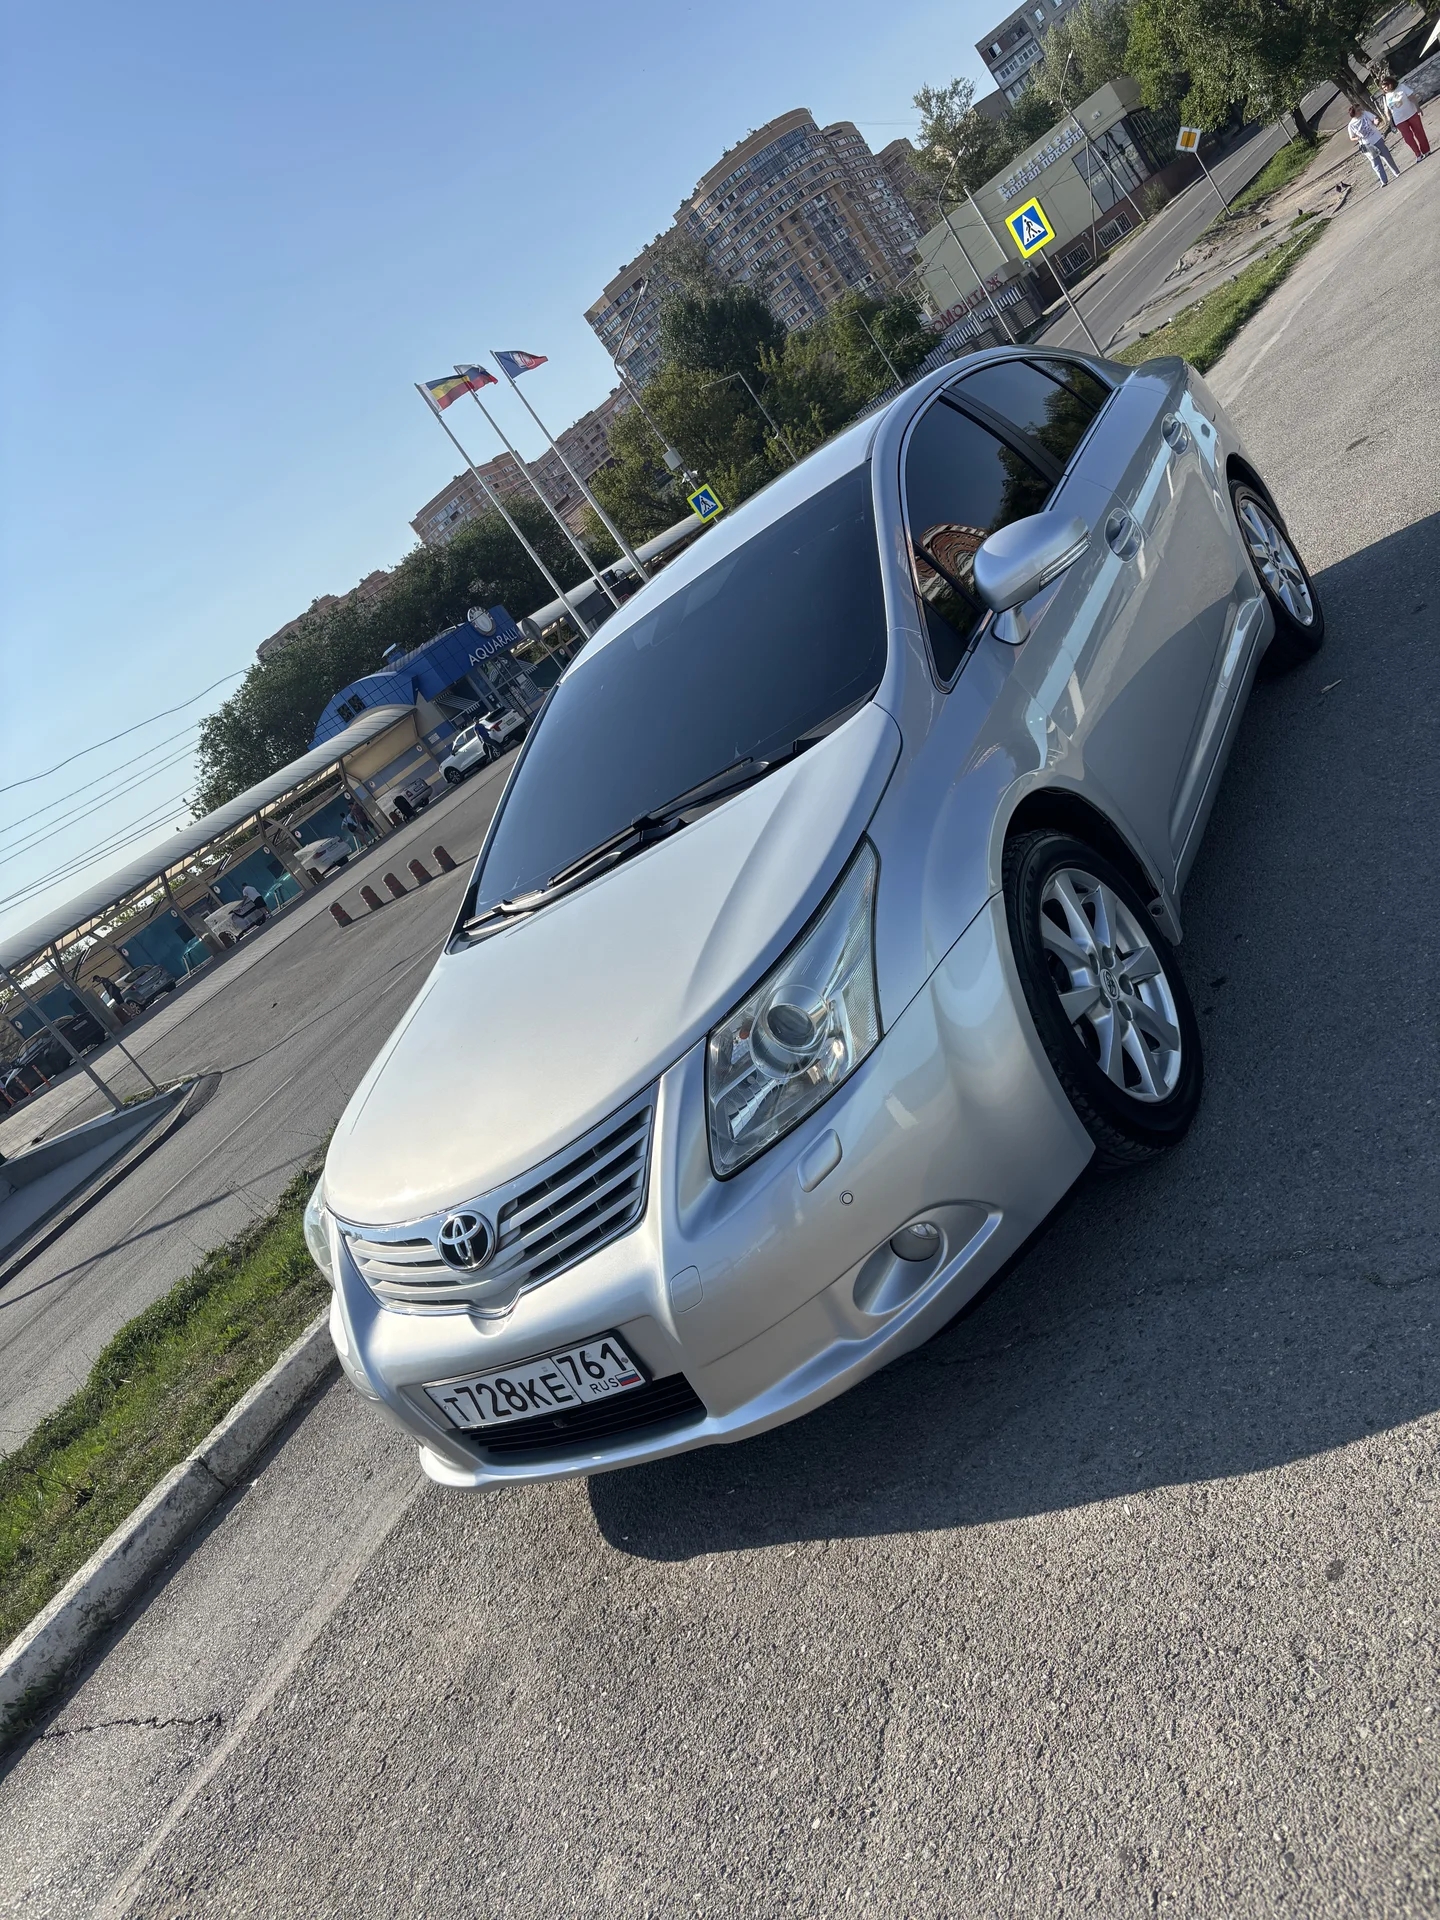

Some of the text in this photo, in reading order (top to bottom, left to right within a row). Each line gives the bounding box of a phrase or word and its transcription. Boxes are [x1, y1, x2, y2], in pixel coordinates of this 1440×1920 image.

[468, 627, 518, 666] AQUARALLY
[556, 1343, 626, 1386] 761
[589, 1377, 619, 1395] RUS
